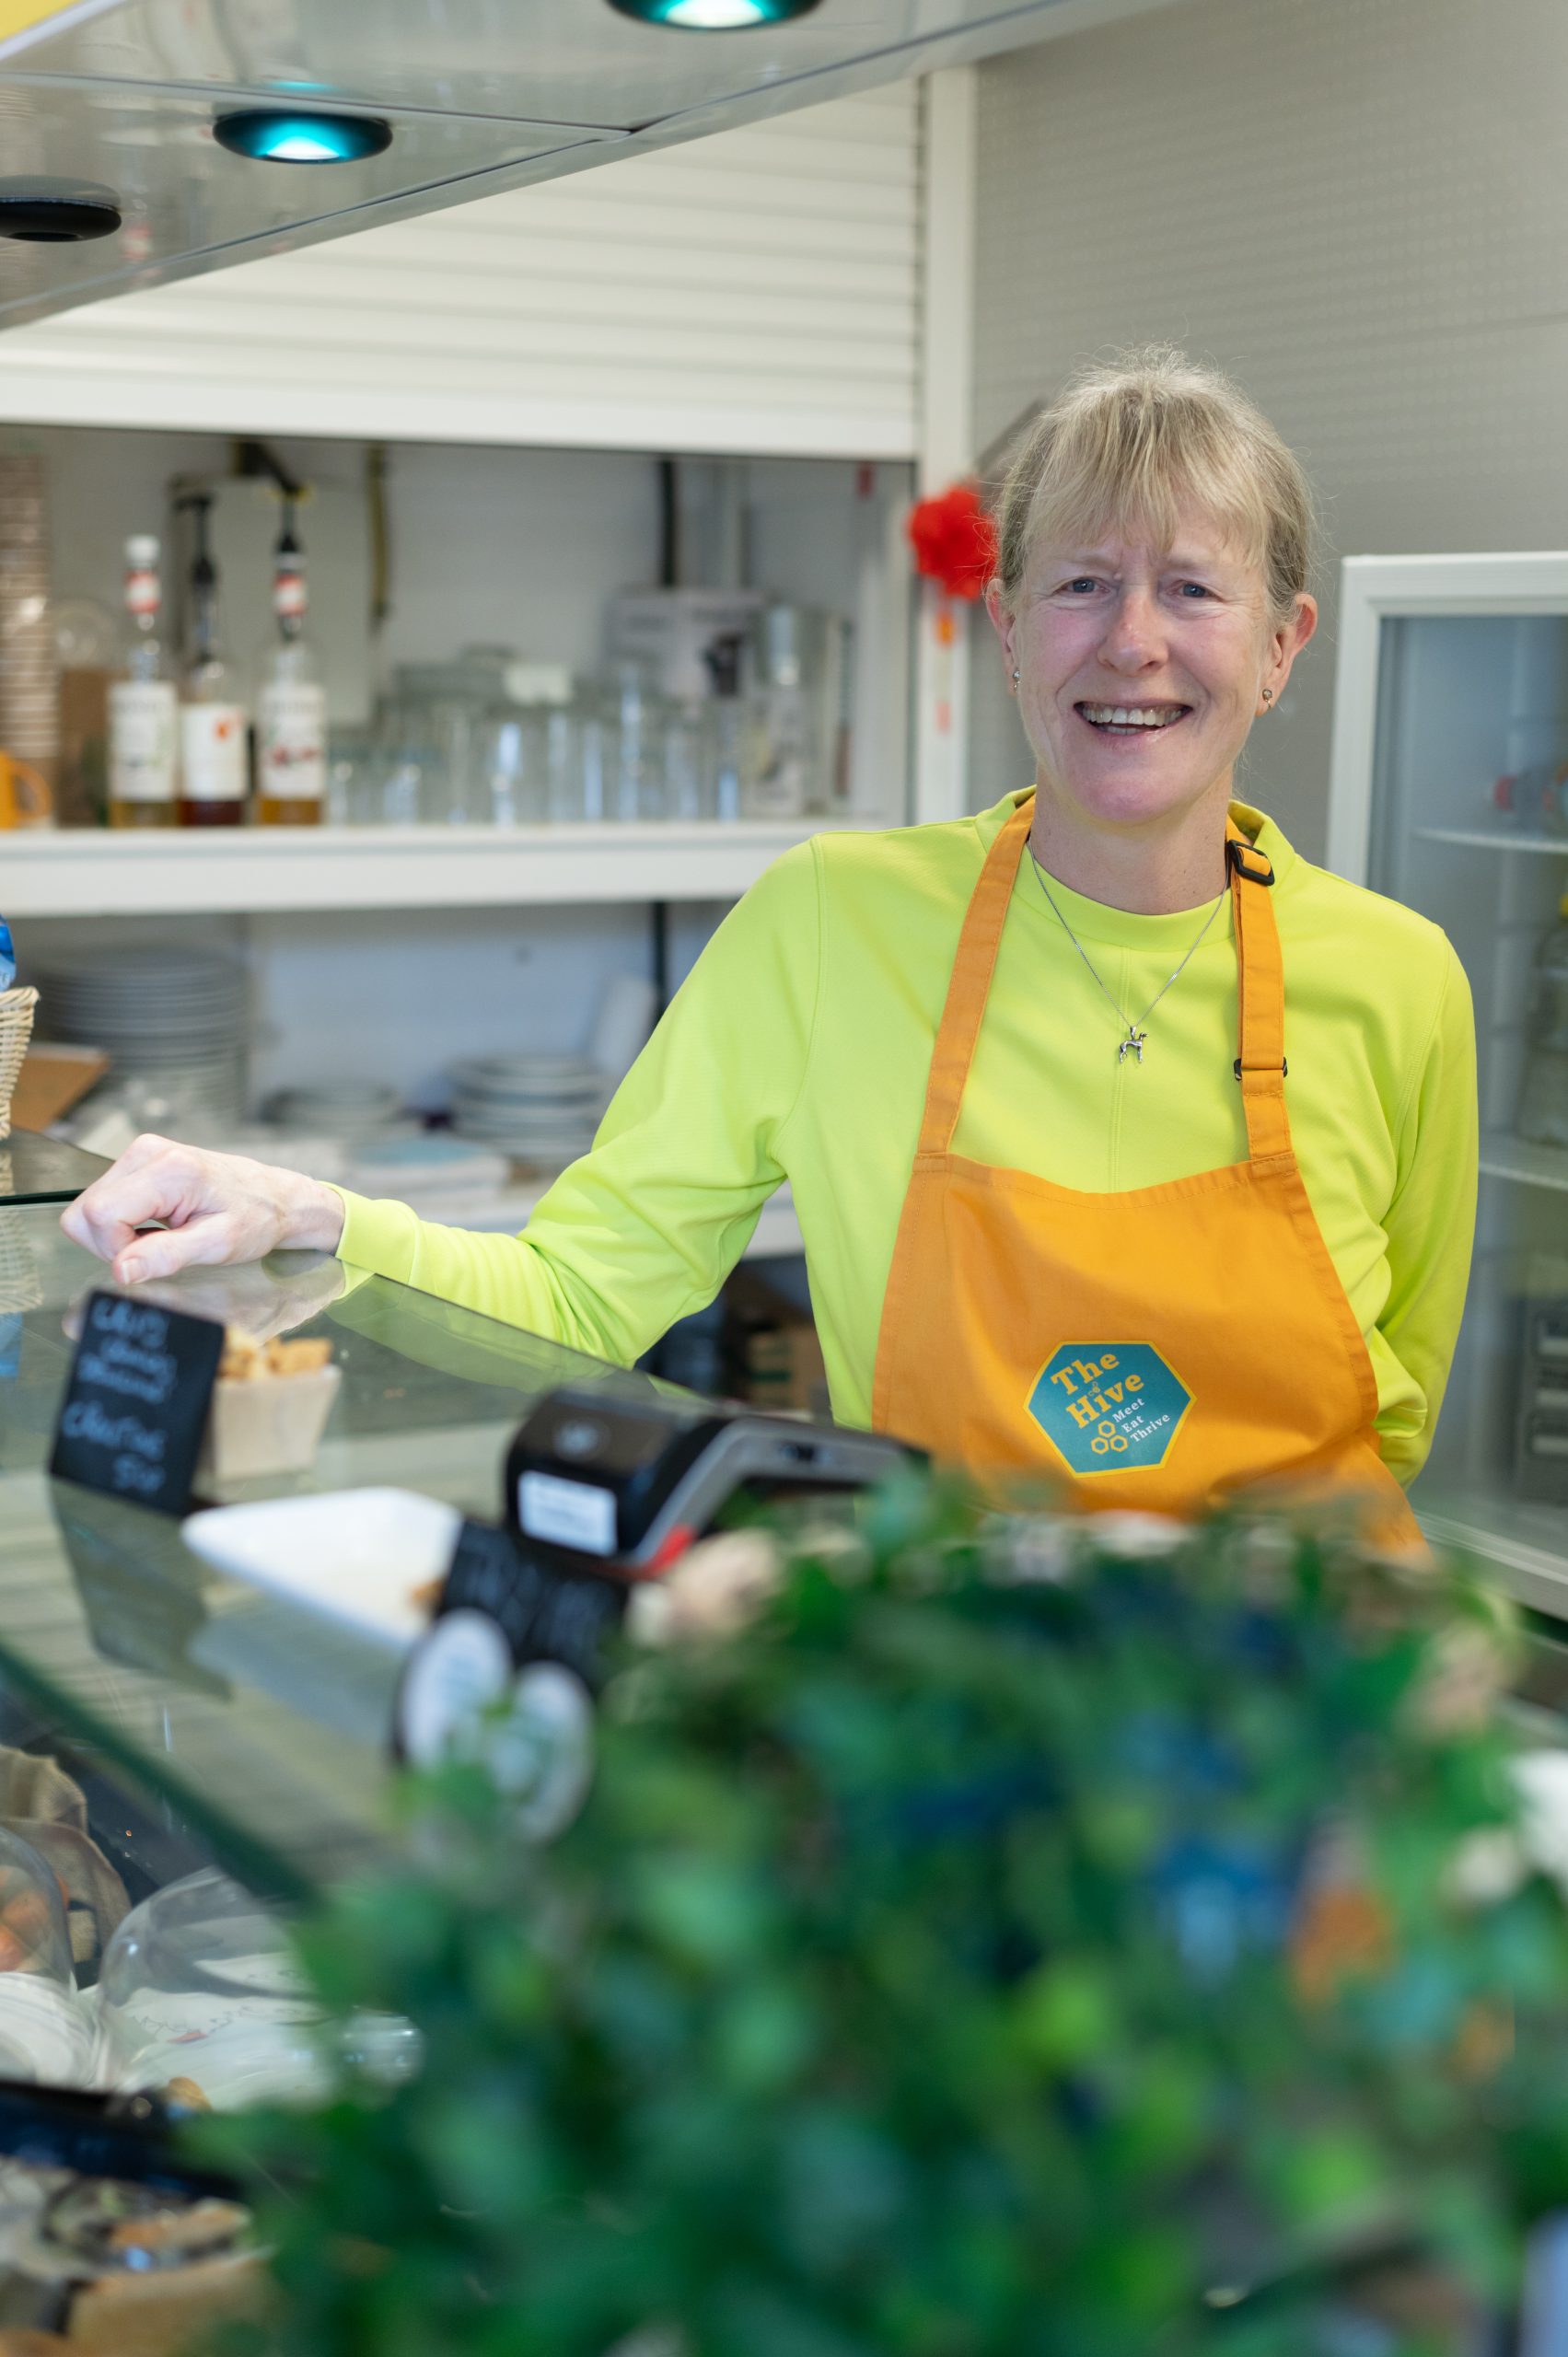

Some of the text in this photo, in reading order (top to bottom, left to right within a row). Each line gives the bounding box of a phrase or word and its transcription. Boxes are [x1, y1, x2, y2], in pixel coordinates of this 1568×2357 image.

[1051, 1353, 1120, 1396] The
[1065, 1374, 1144, 1429] Hive
[1112, 1398, 1144, 1422] Meet
[1121, 1415, 1144, 1434] Eat
[1130, 1413, 1170, 1443] Thrive
